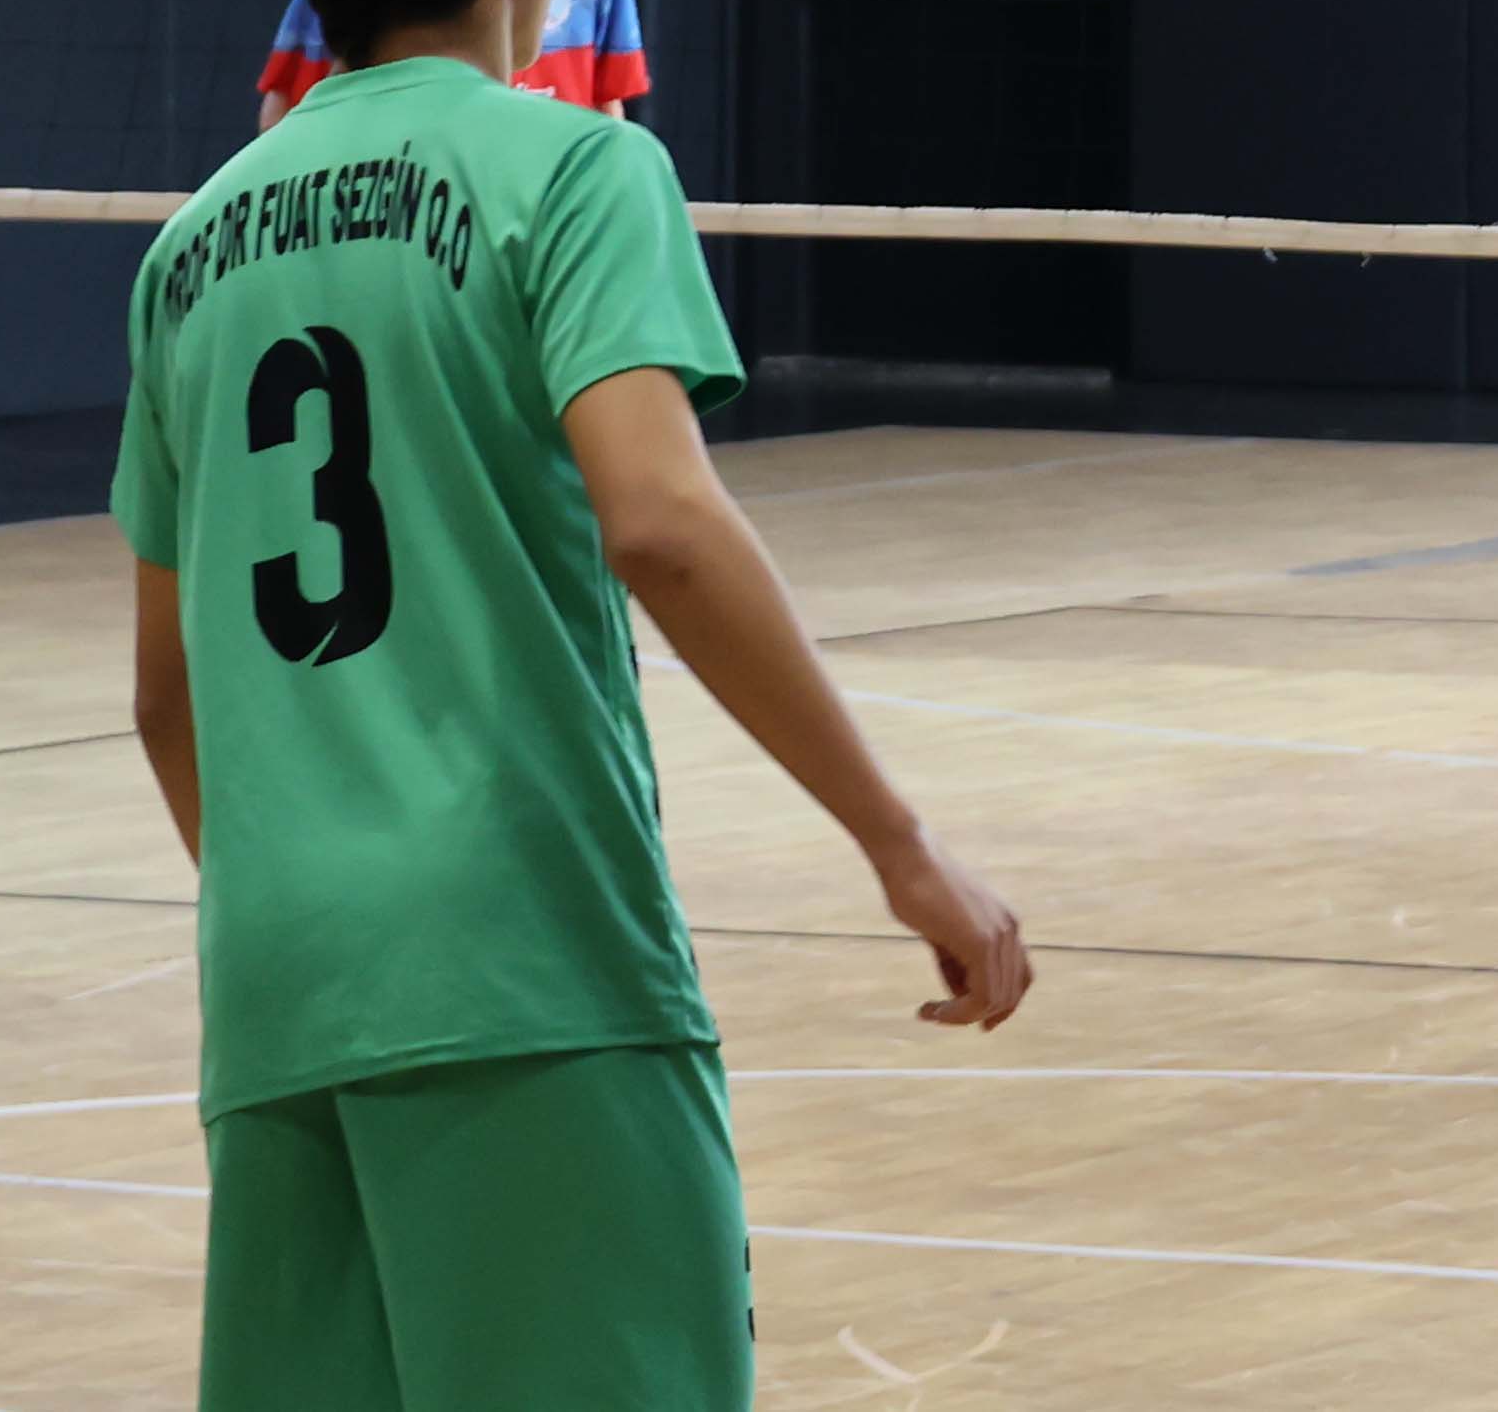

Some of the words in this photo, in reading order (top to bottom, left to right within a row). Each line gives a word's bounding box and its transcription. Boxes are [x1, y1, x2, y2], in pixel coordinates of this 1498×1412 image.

[213, 190, 252, 282] DR
[254, 168, 330, 261] FUAT
[331, 140, 427, 244] SEZGİN
[247, 325, 393, 668] 3
